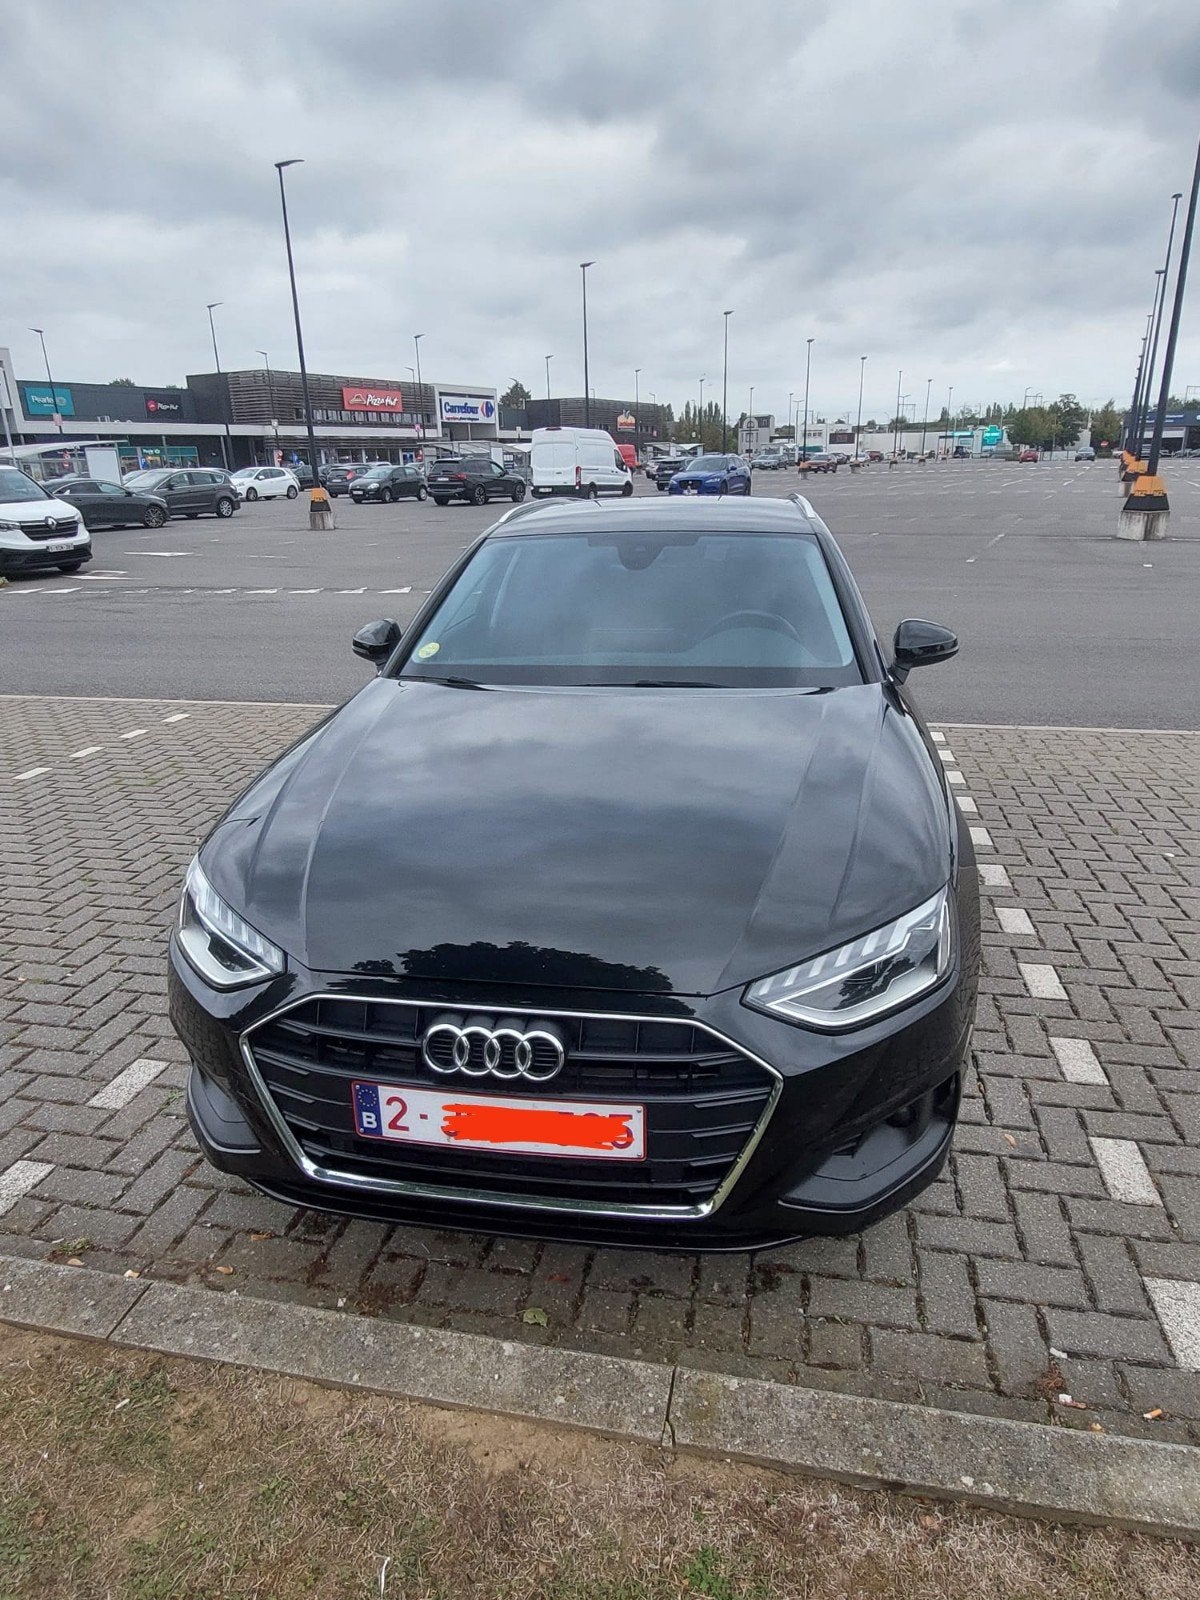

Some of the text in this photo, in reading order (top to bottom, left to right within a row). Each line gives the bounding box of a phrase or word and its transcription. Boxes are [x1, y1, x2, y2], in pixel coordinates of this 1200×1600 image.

[366, 394, 398, 406] Pizza Hut
[444, 401, 479, 414] Carrefour
[362, 1111, 378, 1130] B
